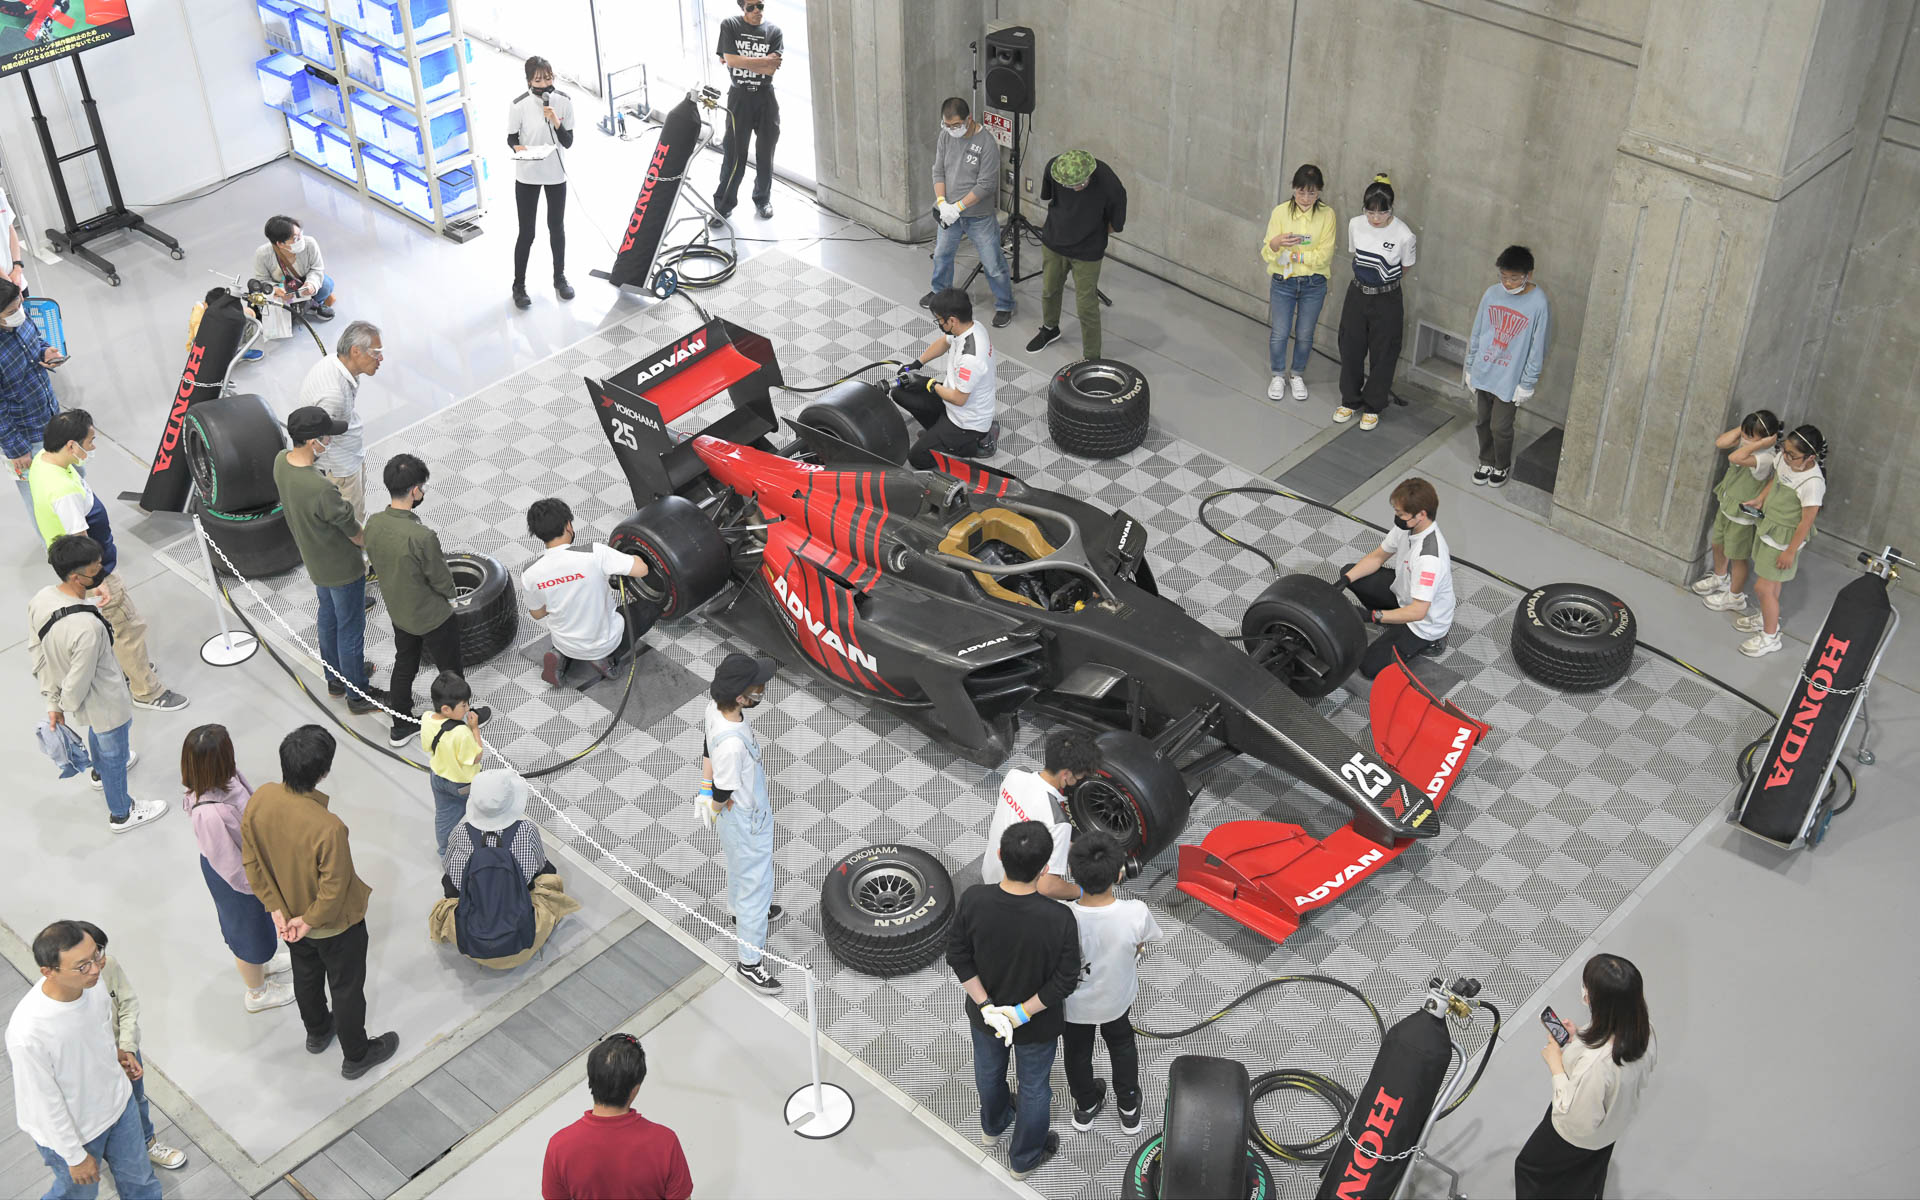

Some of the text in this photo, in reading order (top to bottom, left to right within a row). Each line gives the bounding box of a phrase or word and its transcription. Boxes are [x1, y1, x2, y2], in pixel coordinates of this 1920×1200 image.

[735, 40, 751, 50] WE
[966, 154, 978, 165] 92
[619, 140, 670, 255] HONDA
[637, 338, 706, 386] ADVAN
[1110, 377, 1143, 405] ADVAN
[153, 342, 206, 475] HONDA
[614, 401, 660, 431] YOKOHAMA
[611, 417, 639, 451] 25
[1117, 520, 1133, 551] ADVAN
[536, 572, 585, 590] HONDA
[773, 575, 878, 673] ADVAN
[1526, 589, 1546, 627] ADVAN
[957, 636, 1009, 657] ADVAN
[1764, 633, 1850, 791] HONDA
[1340, 751, 1393, 799] 25
[844, 846, 899, 866] YOKOHAMA
[1294, 848, 1384, 907] ADVAN
[873, 895, 937, 927] ADVAN
[1141, 1146, 1161, 1175] YOKOHAMA
